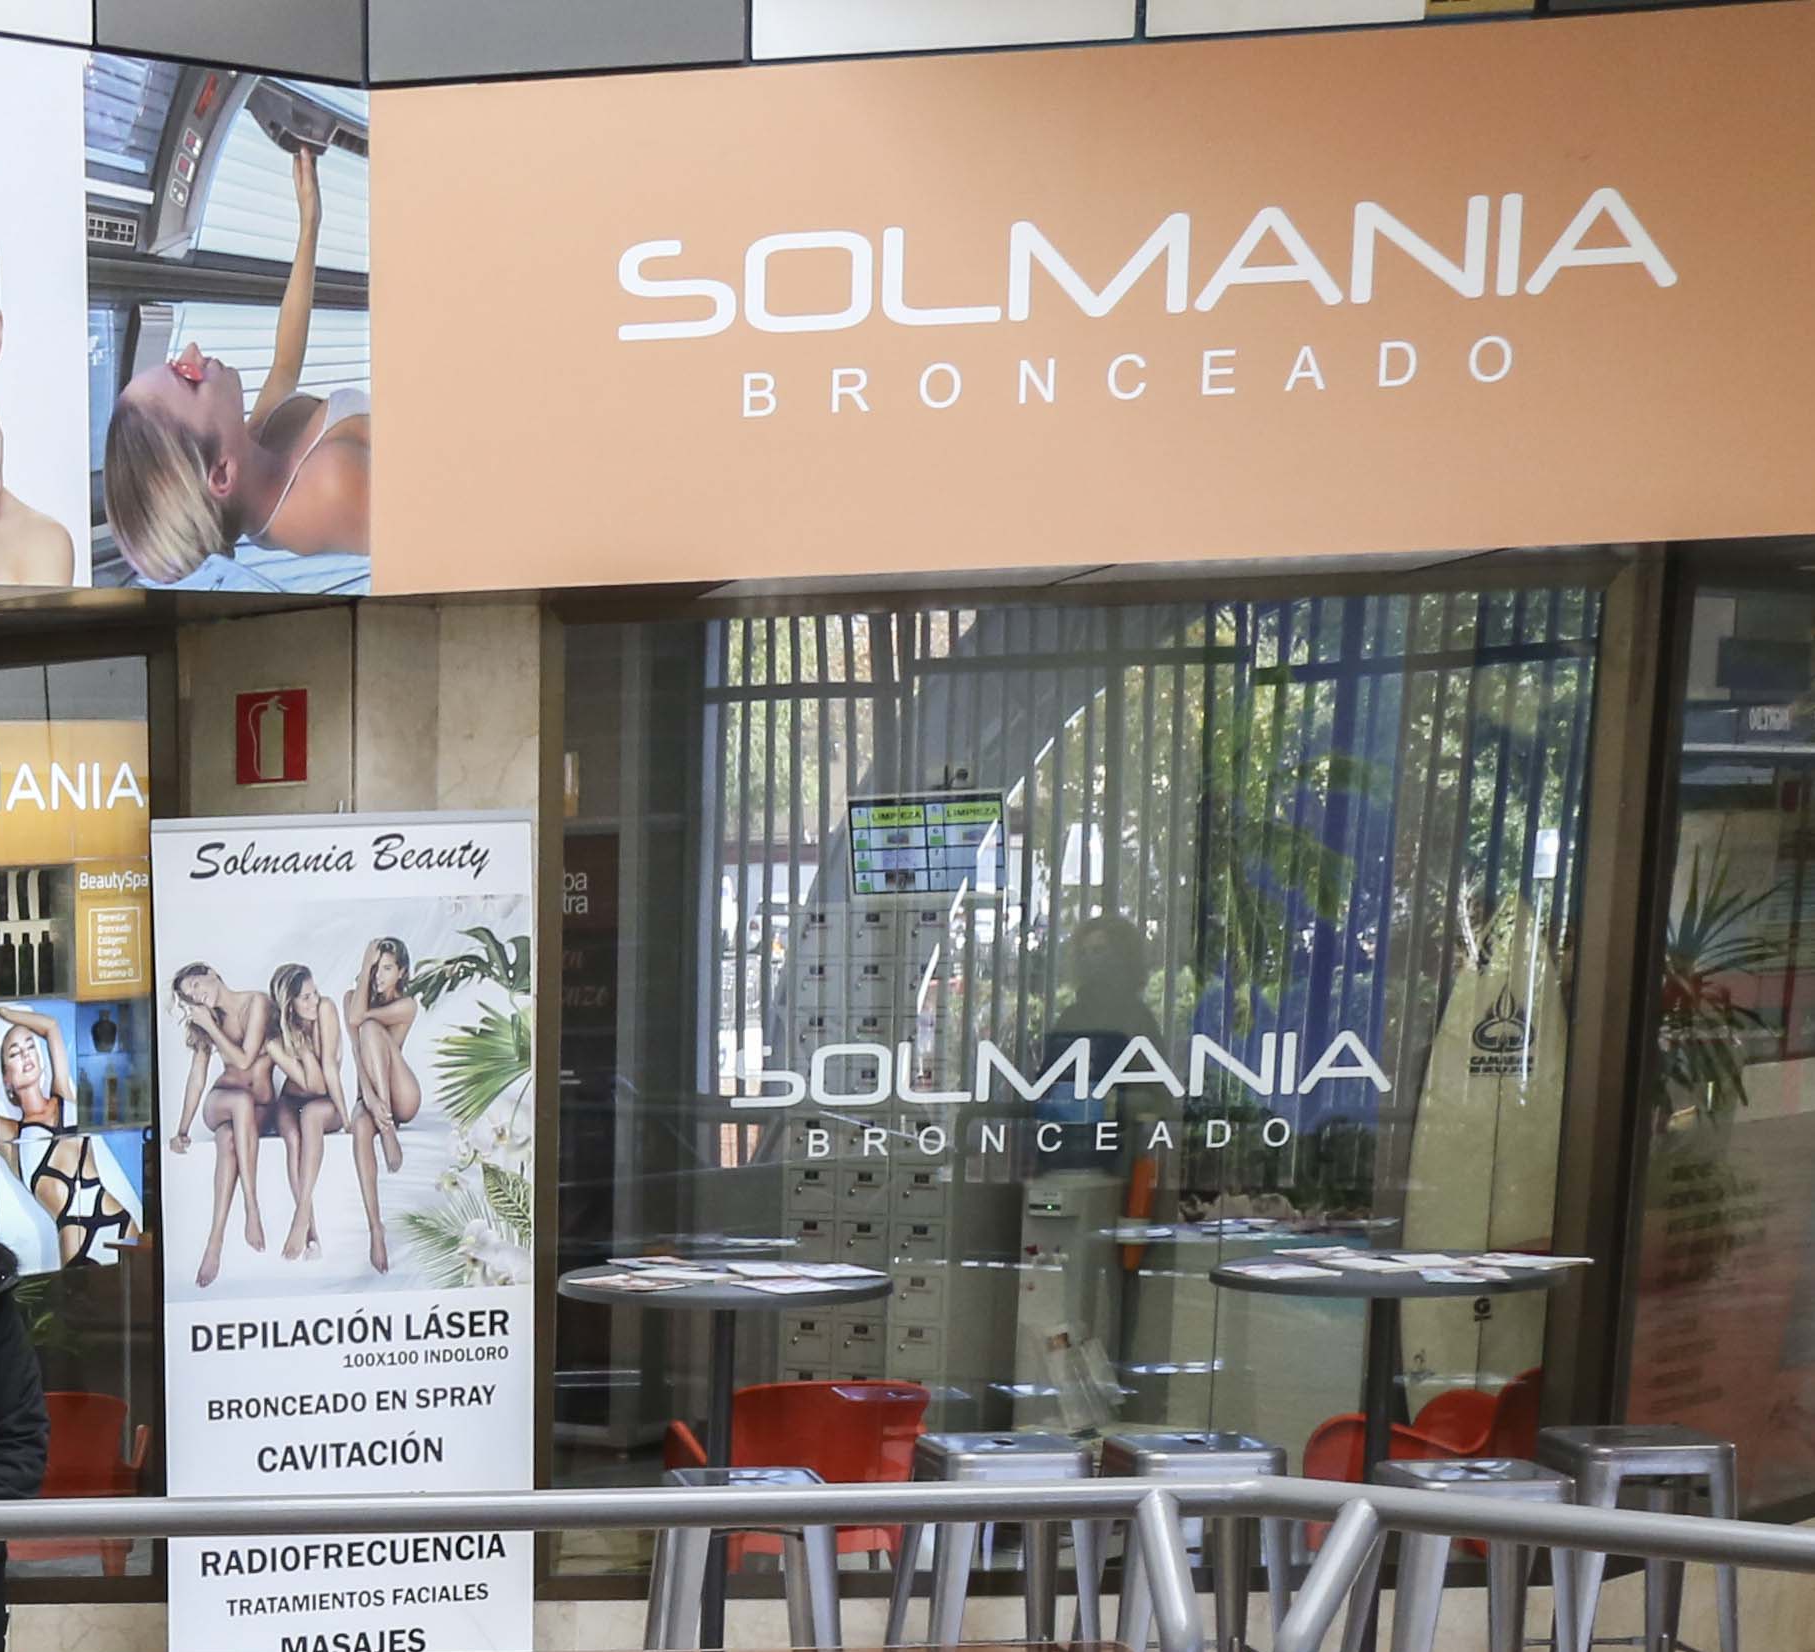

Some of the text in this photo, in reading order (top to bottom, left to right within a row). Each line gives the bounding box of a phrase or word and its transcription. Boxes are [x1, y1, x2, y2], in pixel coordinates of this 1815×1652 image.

[617, 187, 1678, 341] SOLMANIA
[741, 335, 1515, 418] BRONCEADO
[946, 806, 999, 819] LIMPIEZA
[189, 832, 491, 880] Solmania Beauty
[79, 870, 149, 892] BeautySpa
[729, 1030, 1392, 1109] SOLMANIA
[805, 1118, 1292, 1159] BRONCEADO
[191, 1304, 510, 1353] DEPILACIÓN LÁSER
[341, 1345, 509, 1369] 100X100 INDOLORO
[206, 1383, 496, 1421] BRONCEADO EN SPRAY
[256, 1430, 444, 1473] CAVITACIÓN
[200, 1532, 507, 1578] RADIOFRECUENCIA
[225, 1582, 490, 1617] TRATAMIENTOS FACIALES
